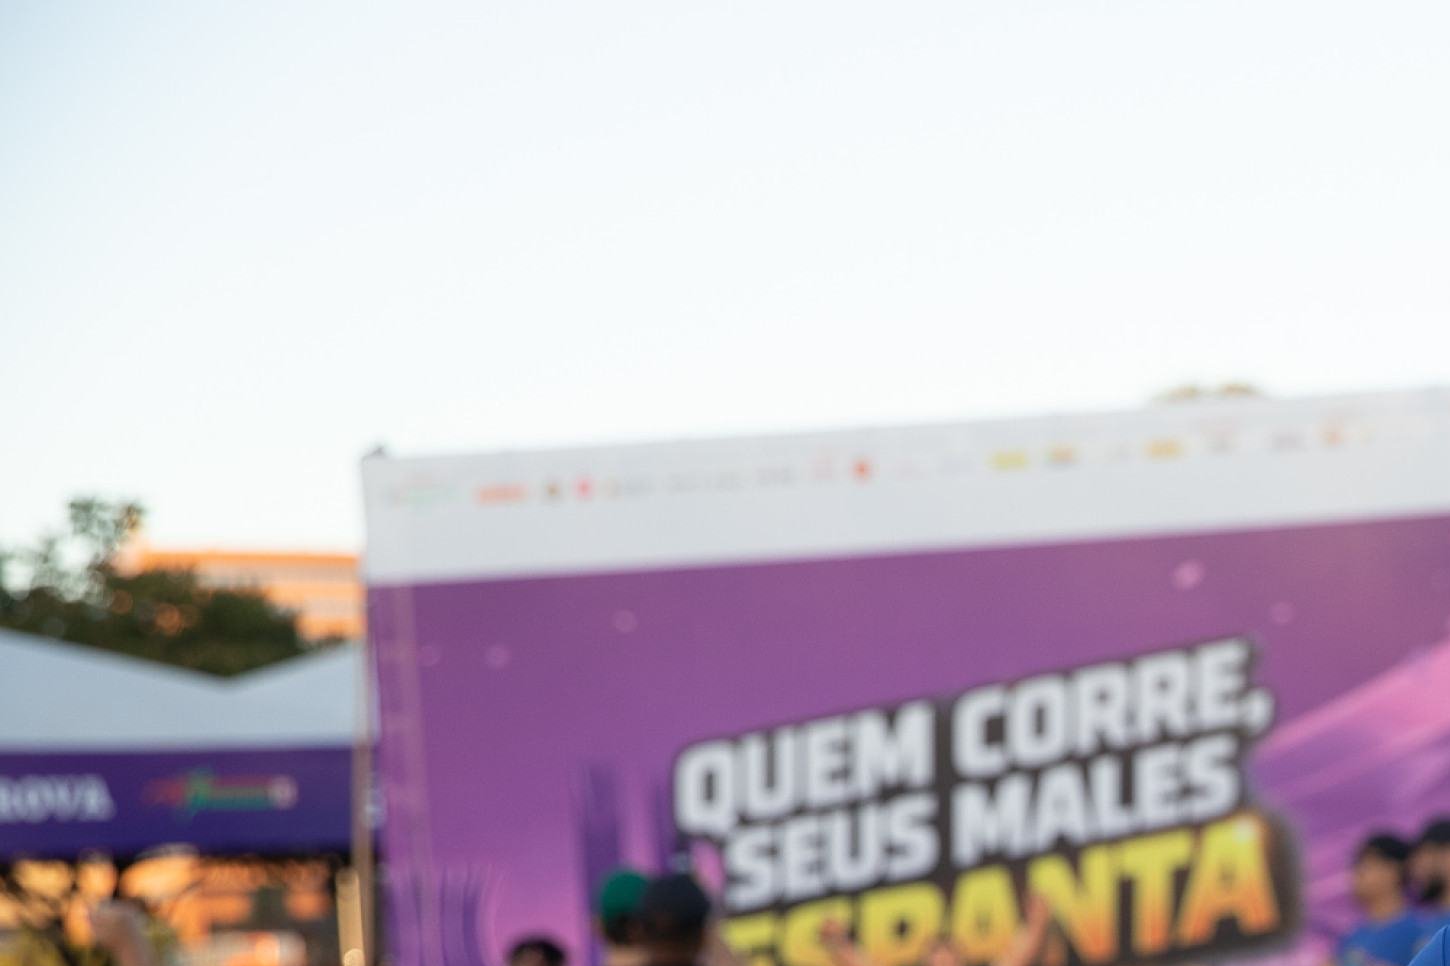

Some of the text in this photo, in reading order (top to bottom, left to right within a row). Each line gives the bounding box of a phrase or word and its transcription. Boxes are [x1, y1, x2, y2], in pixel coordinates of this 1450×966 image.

[674, 637, 1276, 837] QUEM CORRE,
[722, 734, 1243, 909] SEUS MALES
